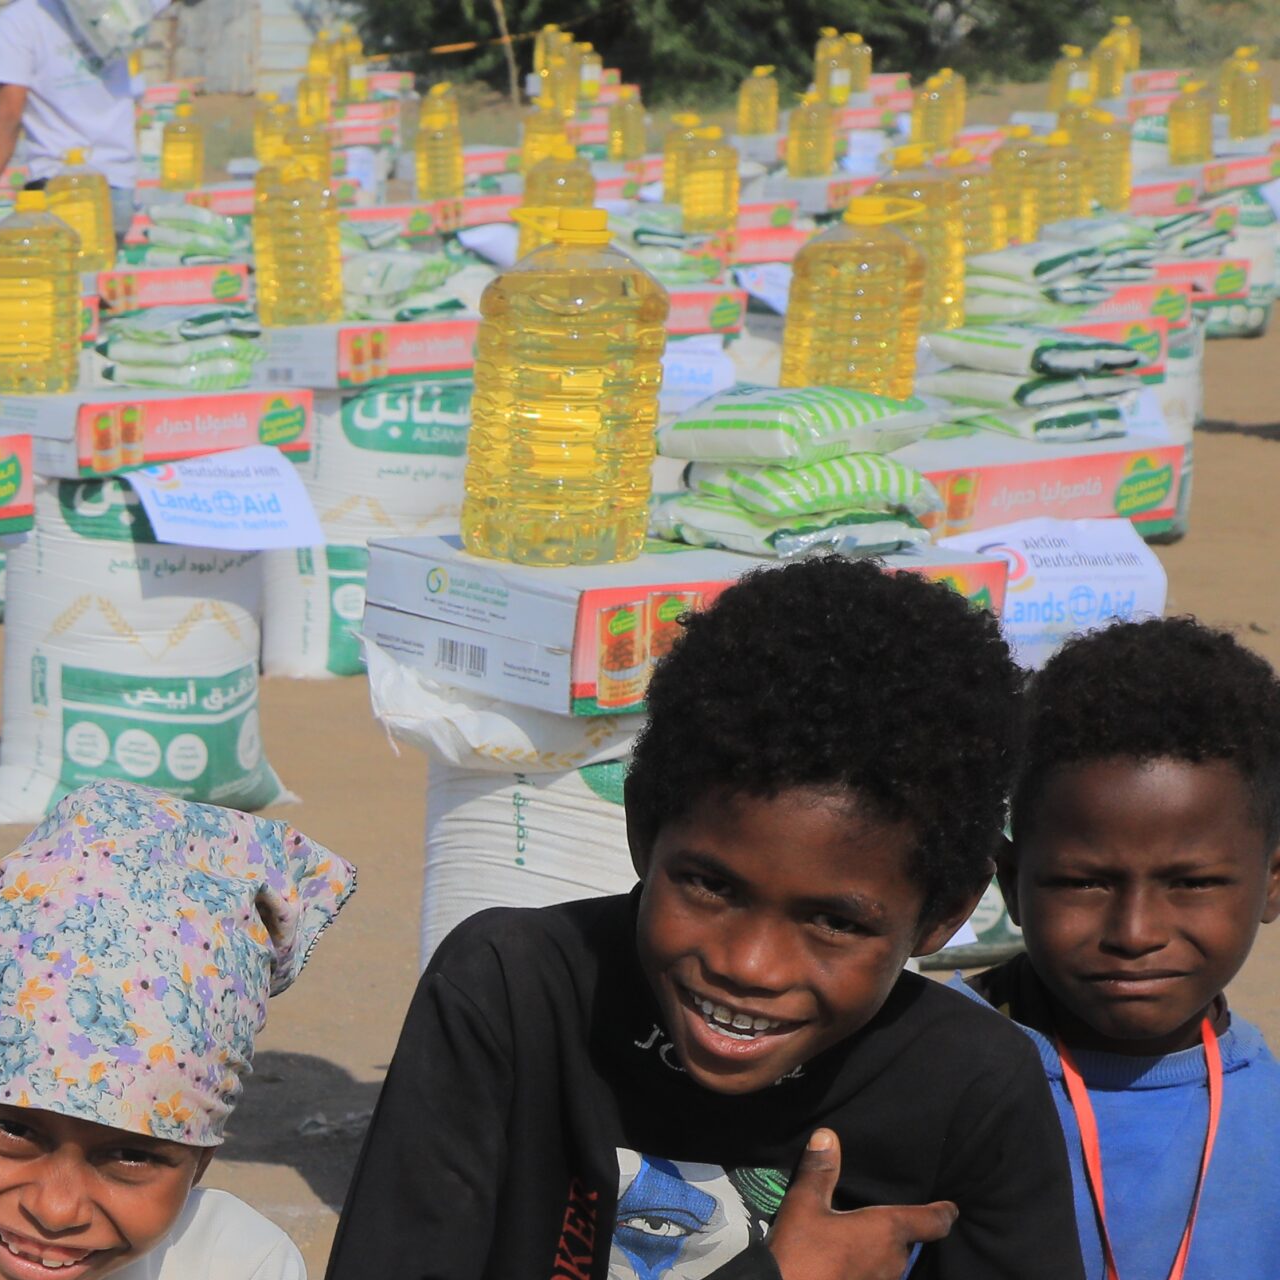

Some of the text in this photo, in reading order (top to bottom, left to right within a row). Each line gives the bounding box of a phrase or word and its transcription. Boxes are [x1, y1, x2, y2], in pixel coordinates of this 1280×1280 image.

[151, 488, 282, 513] Lands Aid
[1023, 536, 1070, 550] Aktion
[1031, 552, 1113, 569] Deutschland
[1097, 591, 1137, 622] Aid
[122, 680, 197, 710] أبيض
